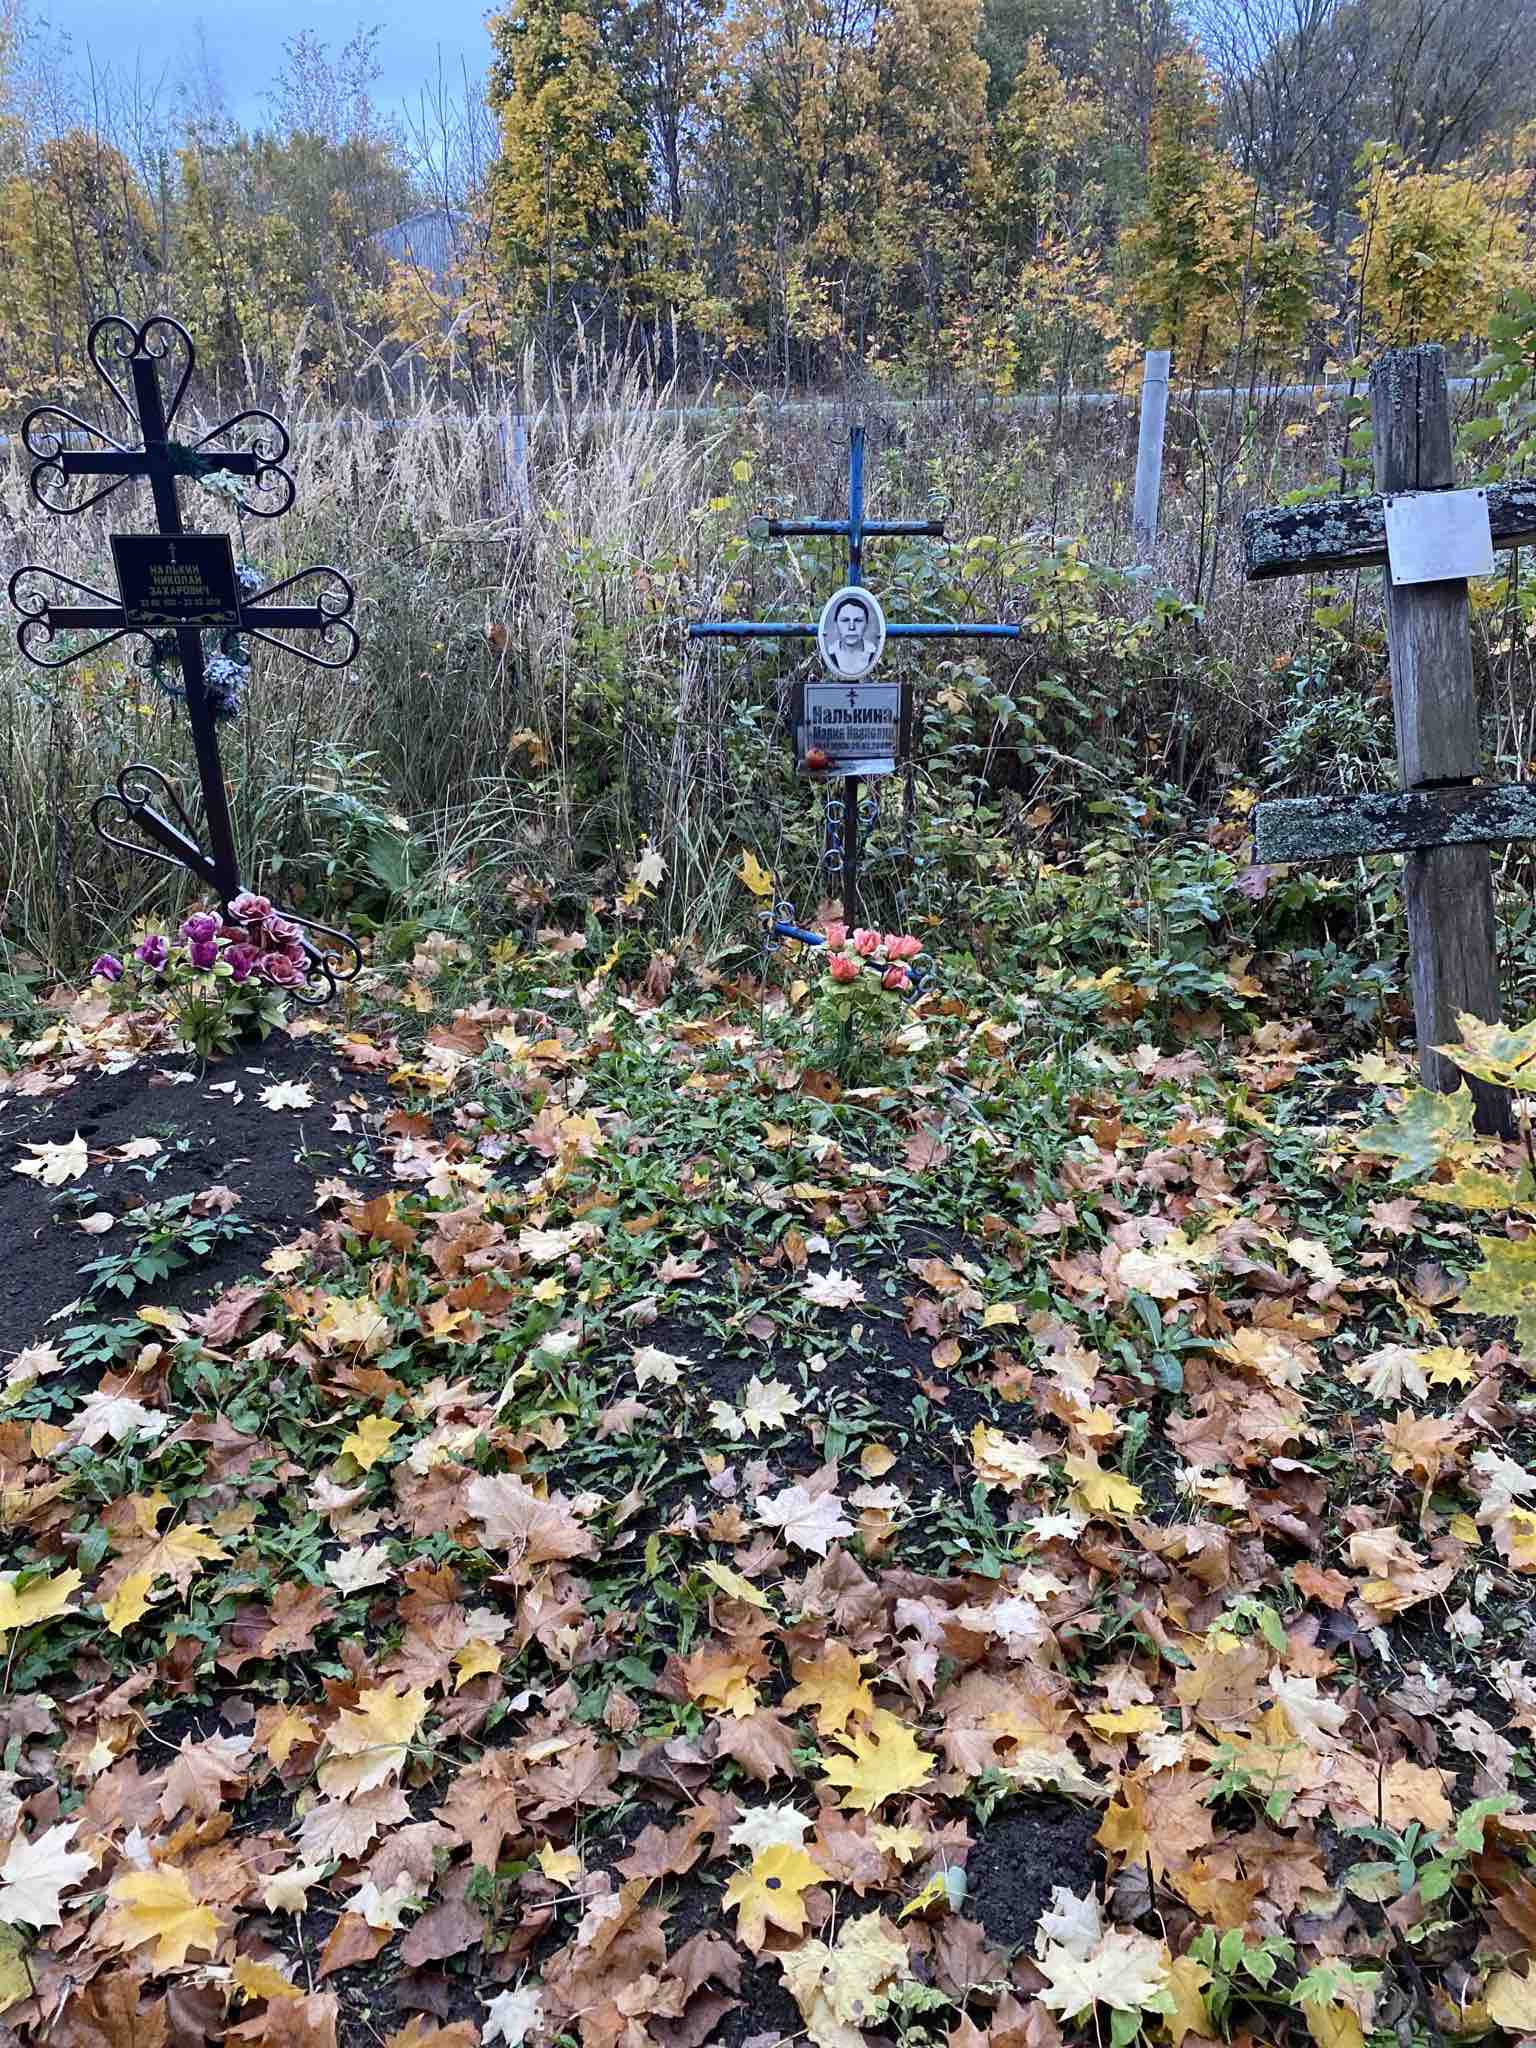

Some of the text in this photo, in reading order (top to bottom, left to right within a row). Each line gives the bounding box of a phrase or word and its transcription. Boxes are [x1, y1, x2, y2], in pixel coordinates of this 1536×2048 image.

[149, 564, 200, 575] НАЛЬКИН
[153, 575, 202, 585] НИКОЛАЙ
[812, 705, 893, 724] Налькина
